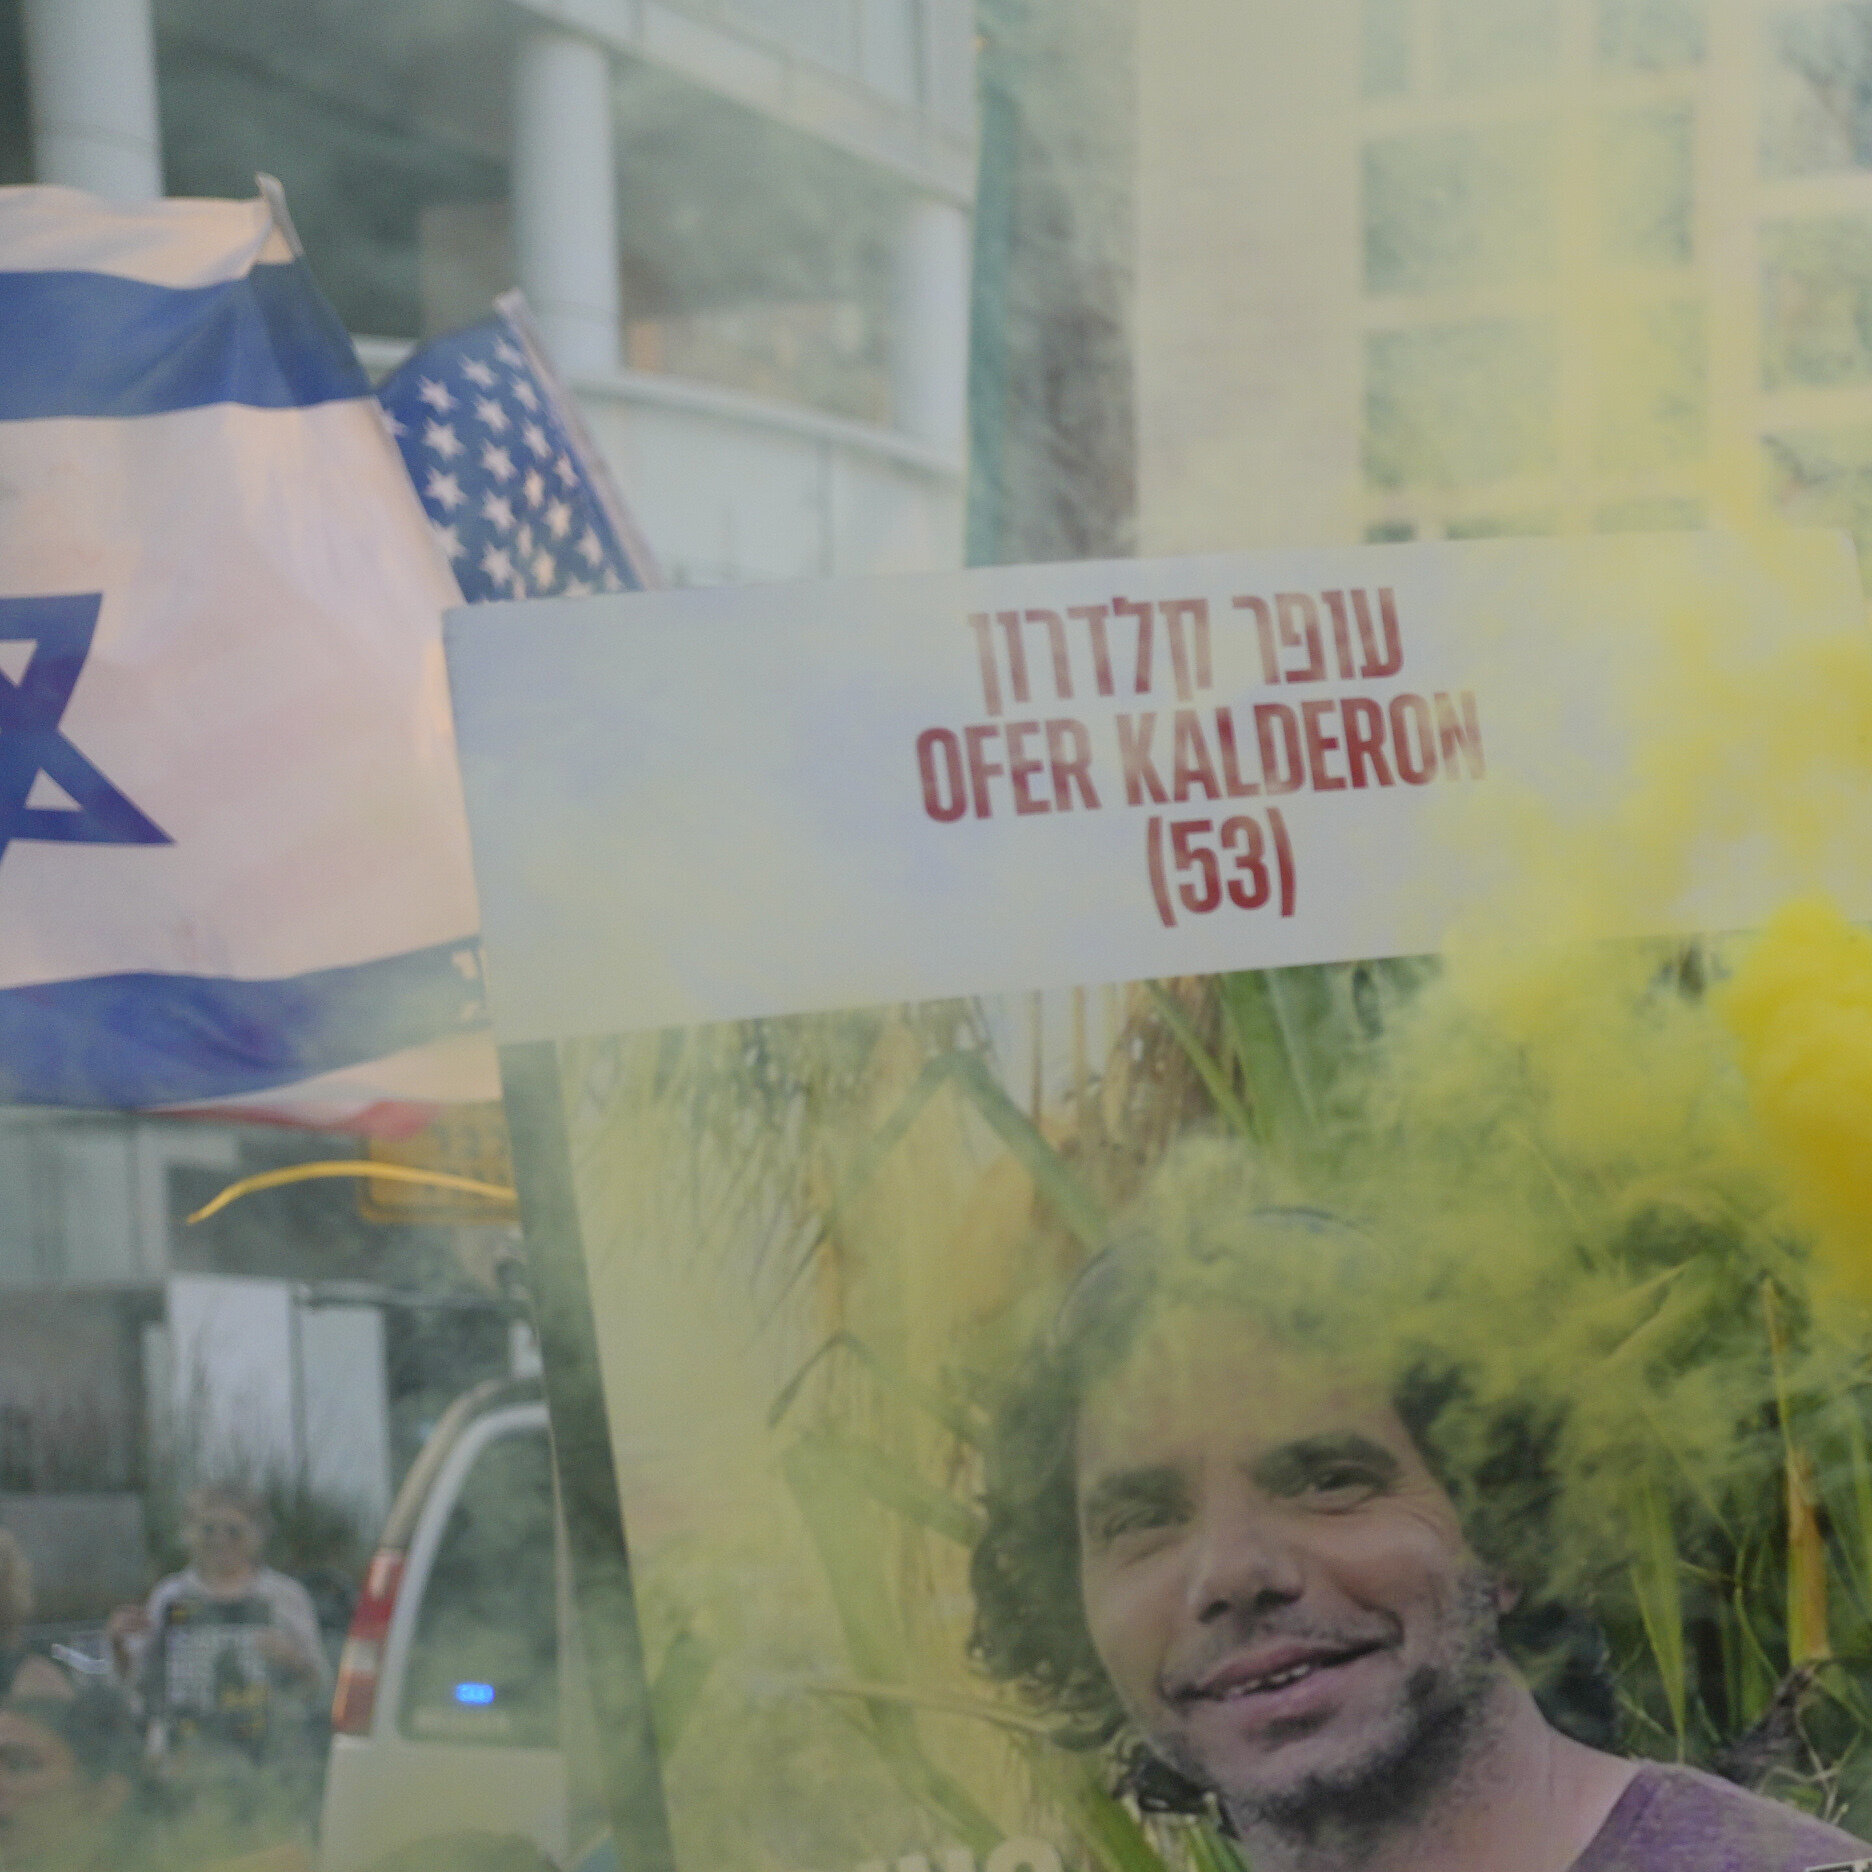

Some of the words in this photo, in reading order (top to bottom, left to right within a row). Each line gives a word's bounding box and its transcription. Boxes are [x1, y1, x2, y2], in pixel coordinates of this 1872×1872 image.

[967, 596, 1213, 717] קלדרון
[1232, 587, 1405, 686] עופר
[915, 718, 1102, 824] OFER
[1116, 690, 1487, 807] KALDERON
[1146, 807, 1298, 928] (53)
